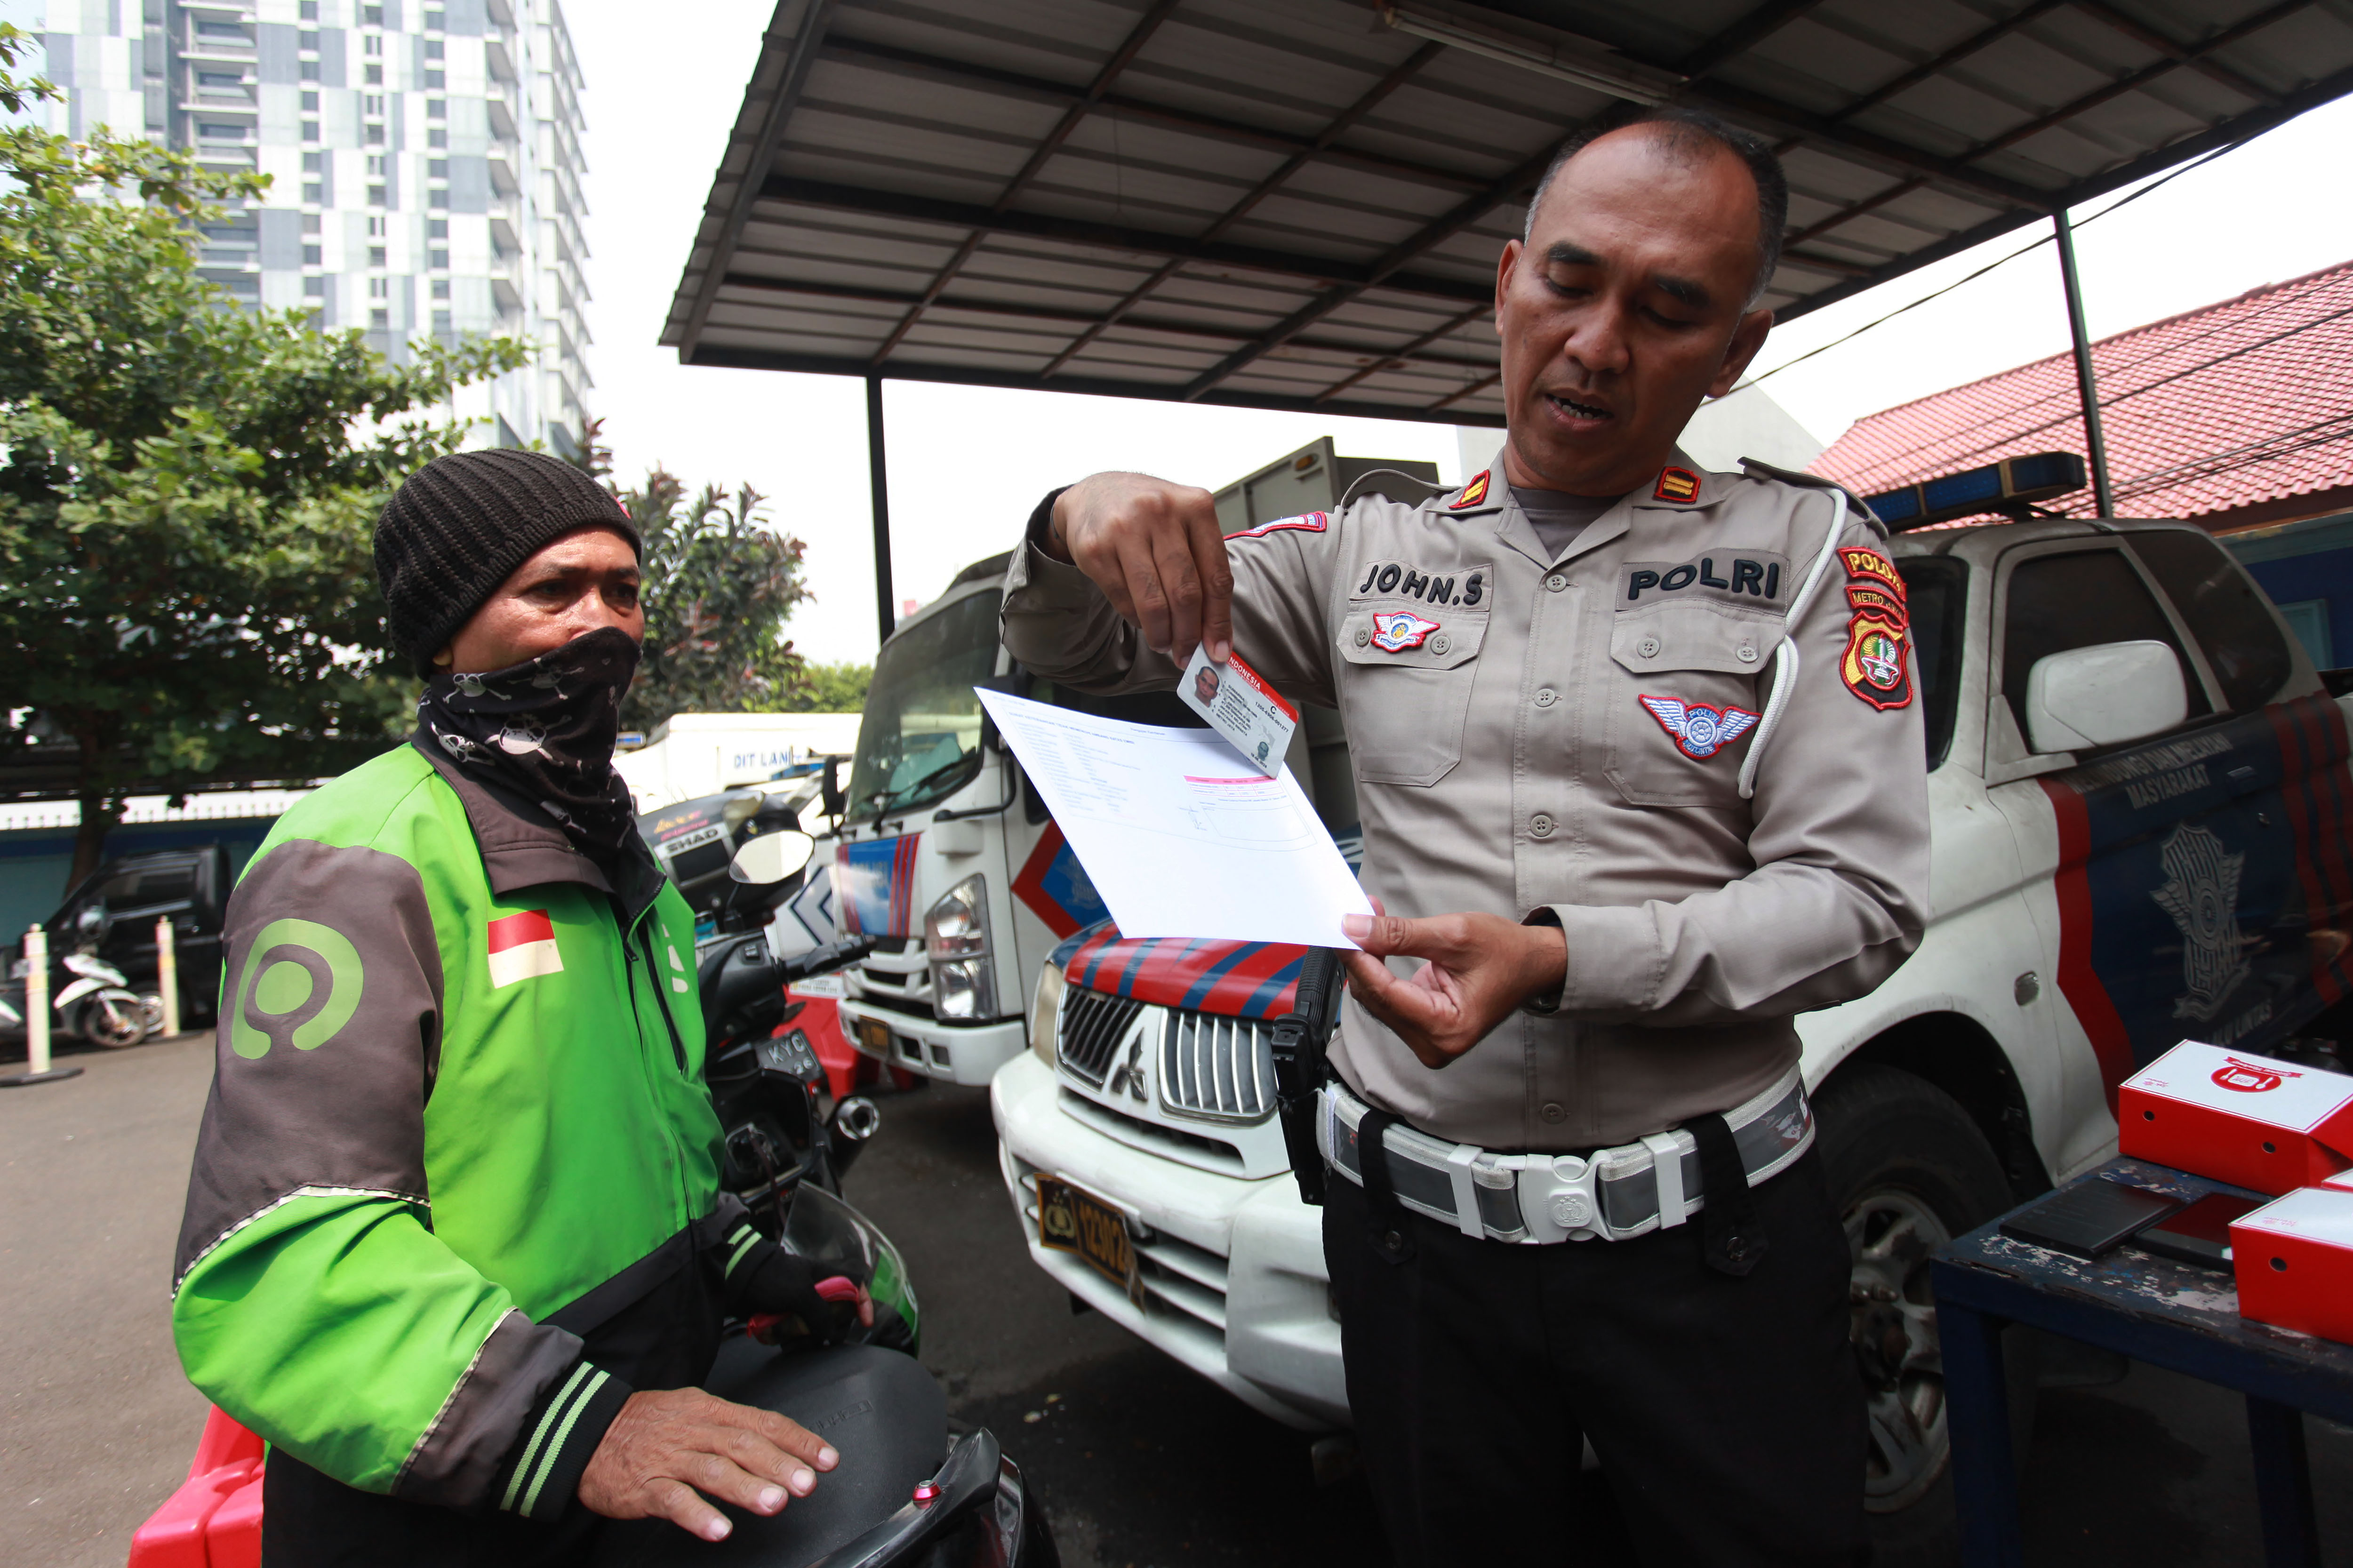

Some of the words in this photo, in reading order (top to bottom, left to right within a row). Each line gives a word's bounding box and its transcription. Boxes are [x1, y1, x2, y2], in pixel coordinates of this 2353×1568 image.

[1360, 564, 1484, 608] JOHN.S
[1629, 557, 1780, 601] POLRI
[1852, 592, 1883, 605] METRO
[1229, 656, 1261, 690] NDONESIA
[1270, 706, 1277, 714] C
[1688, 709, 1720, 722] POLISI
[735, 752, 755, 768] DIT
[2146, 745, 2180, 770] DAN
[2125, 763, 2210, 810] MASYARAKAT
[666, 828, 718, 853] SHAD
[768, 1033, 806, 1064] KYC
